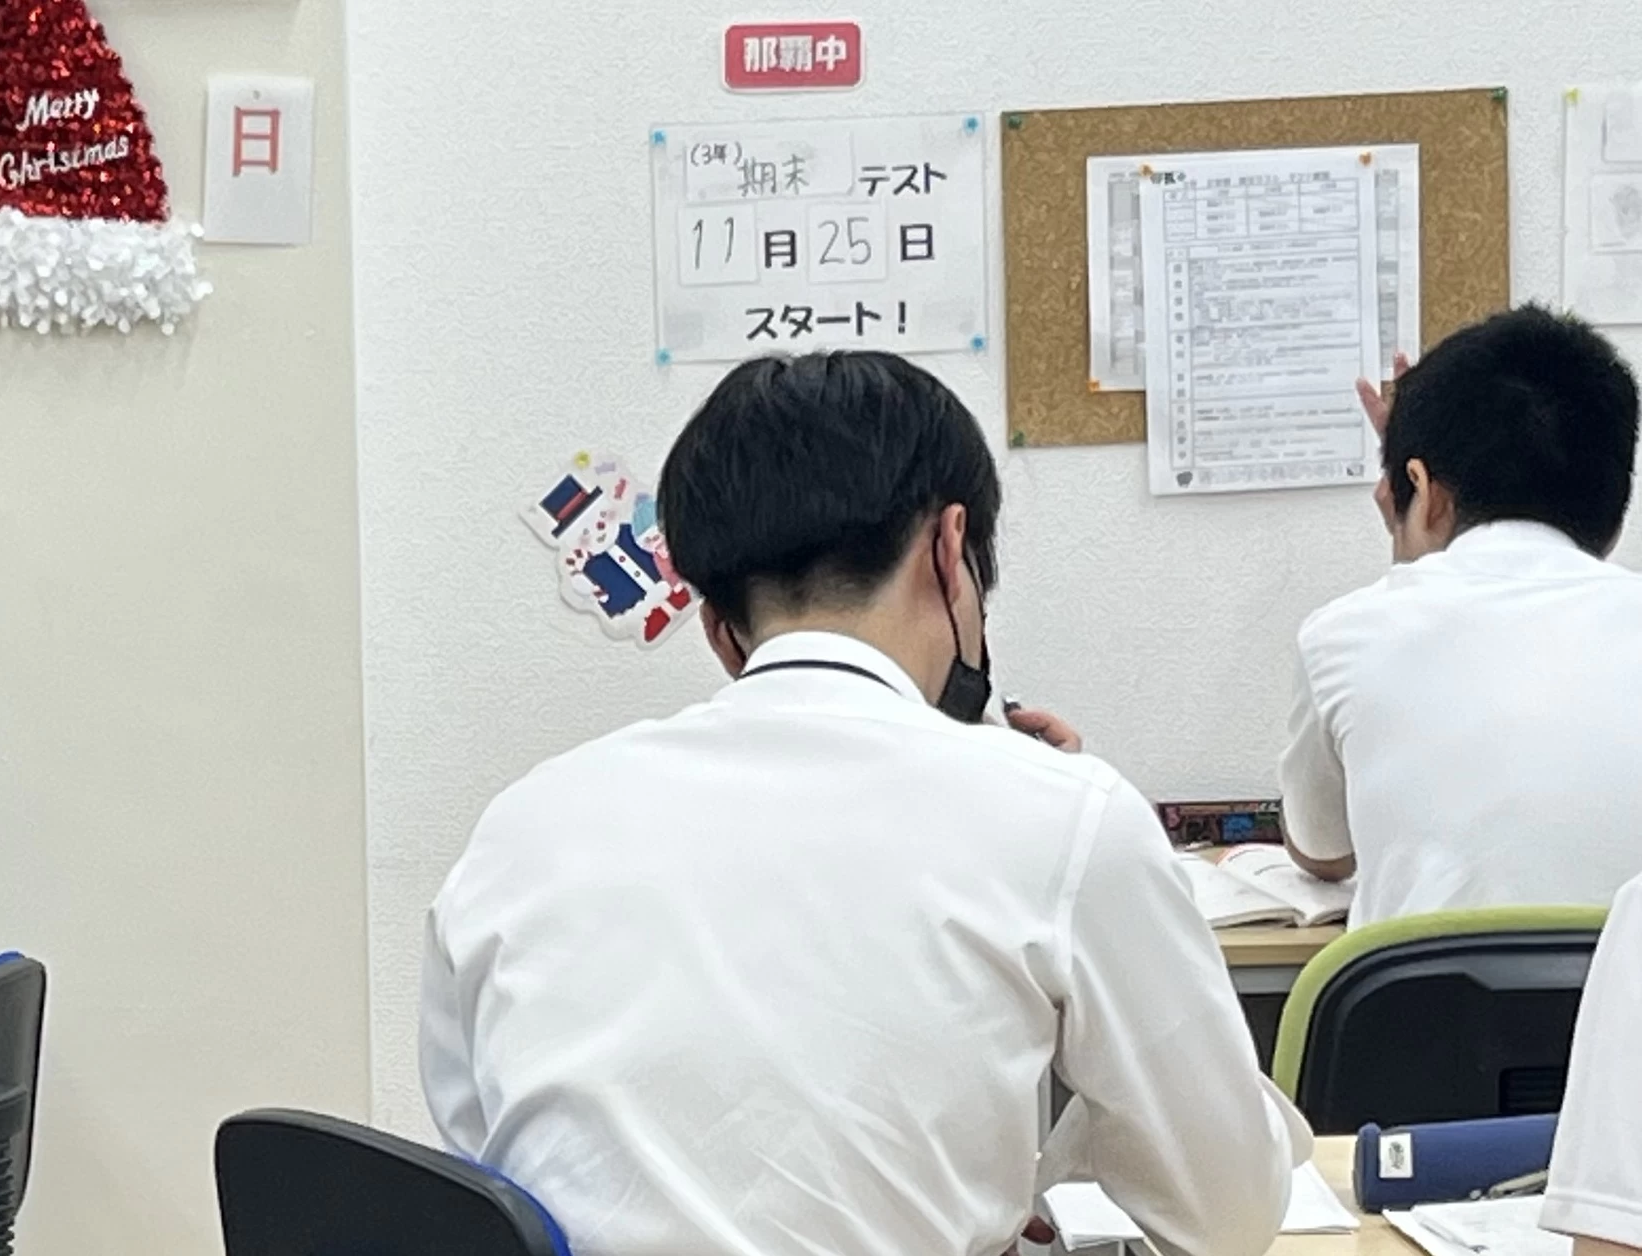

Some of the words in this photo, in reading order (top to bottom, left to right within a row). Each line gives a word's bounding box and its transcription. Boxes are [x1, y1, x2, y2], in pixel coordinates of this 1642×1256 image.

[743, 34, 847, 72] 那覇中
[16, 88, 100, 132] Merry
[859, 162, 947, 196] テスト
